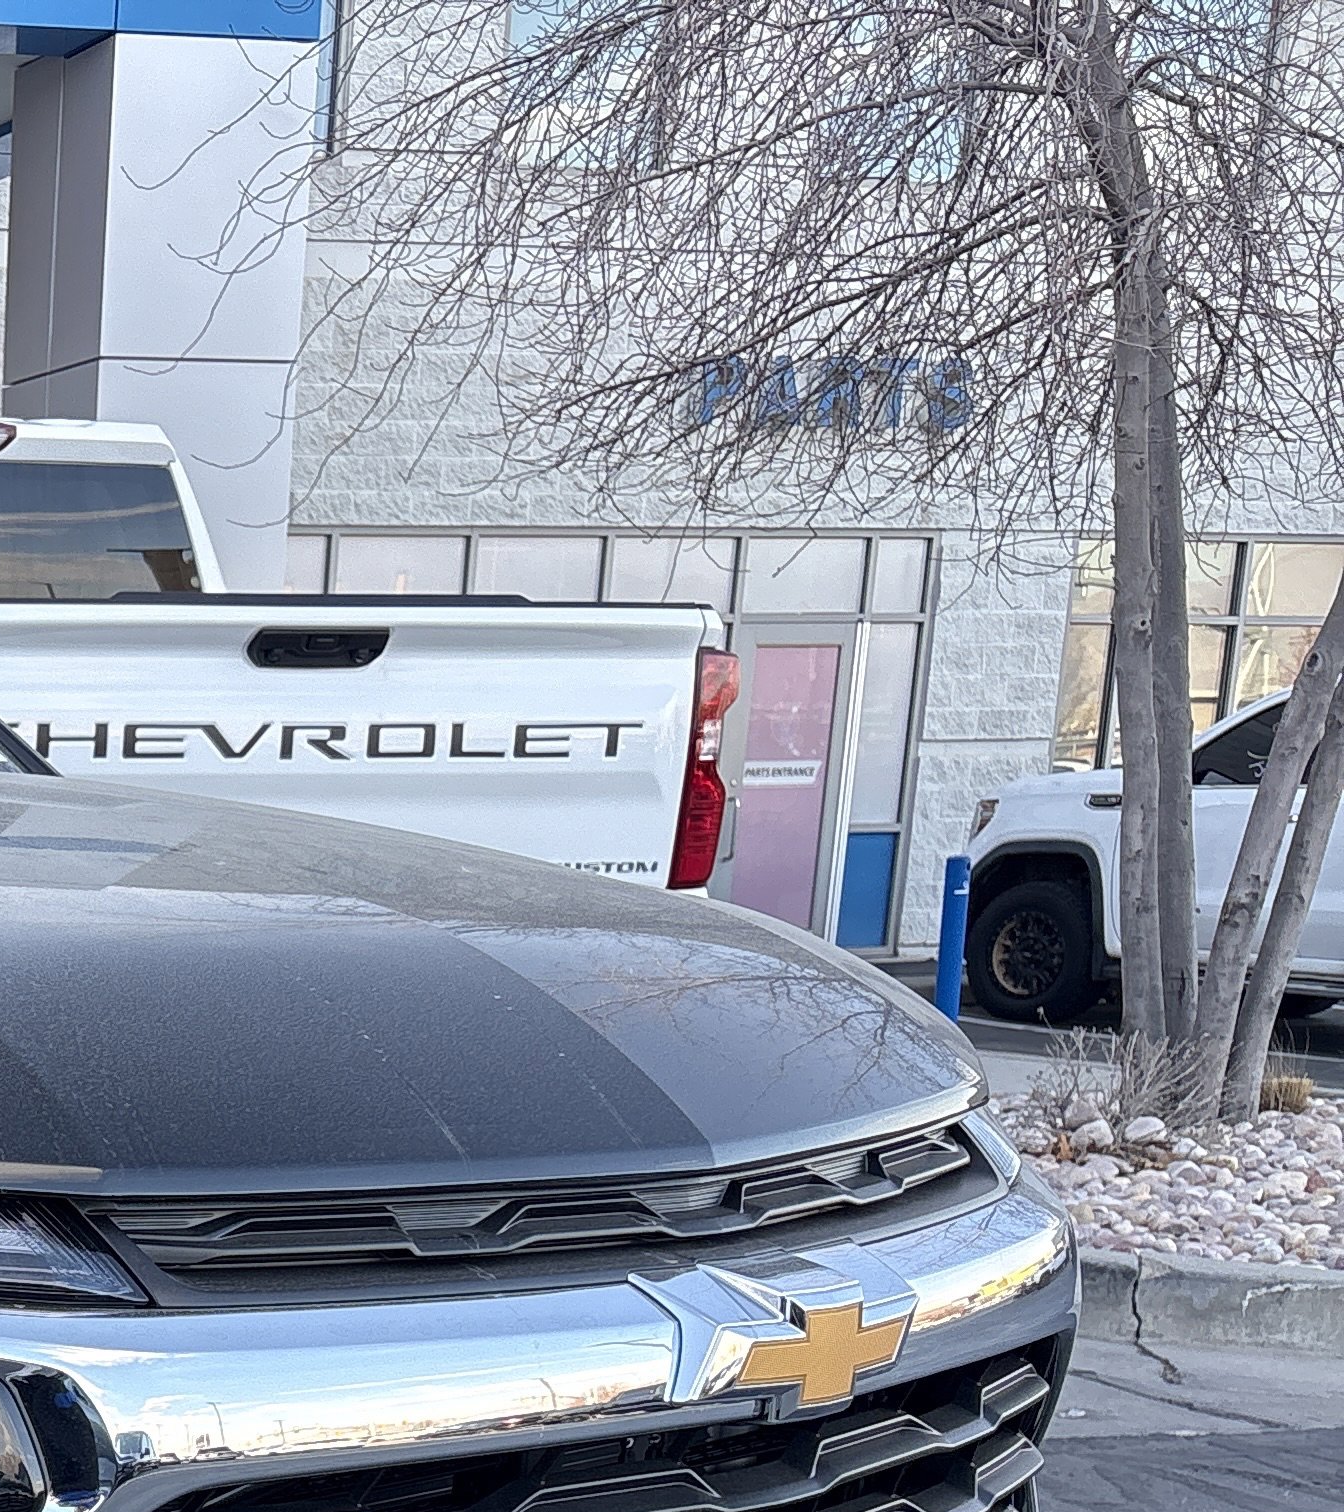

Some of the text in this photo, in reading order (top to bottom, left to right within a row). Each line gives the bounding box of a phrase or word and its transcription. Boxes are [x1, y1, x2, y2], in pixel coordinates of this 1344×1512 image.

[696, 354, 974, 429] PARTS
[8, 720, 644, 760] HEVROLET
[745, 766, 815, 777] PARTS ENTRANCE
[557, 861, 658, 873] USTOM
